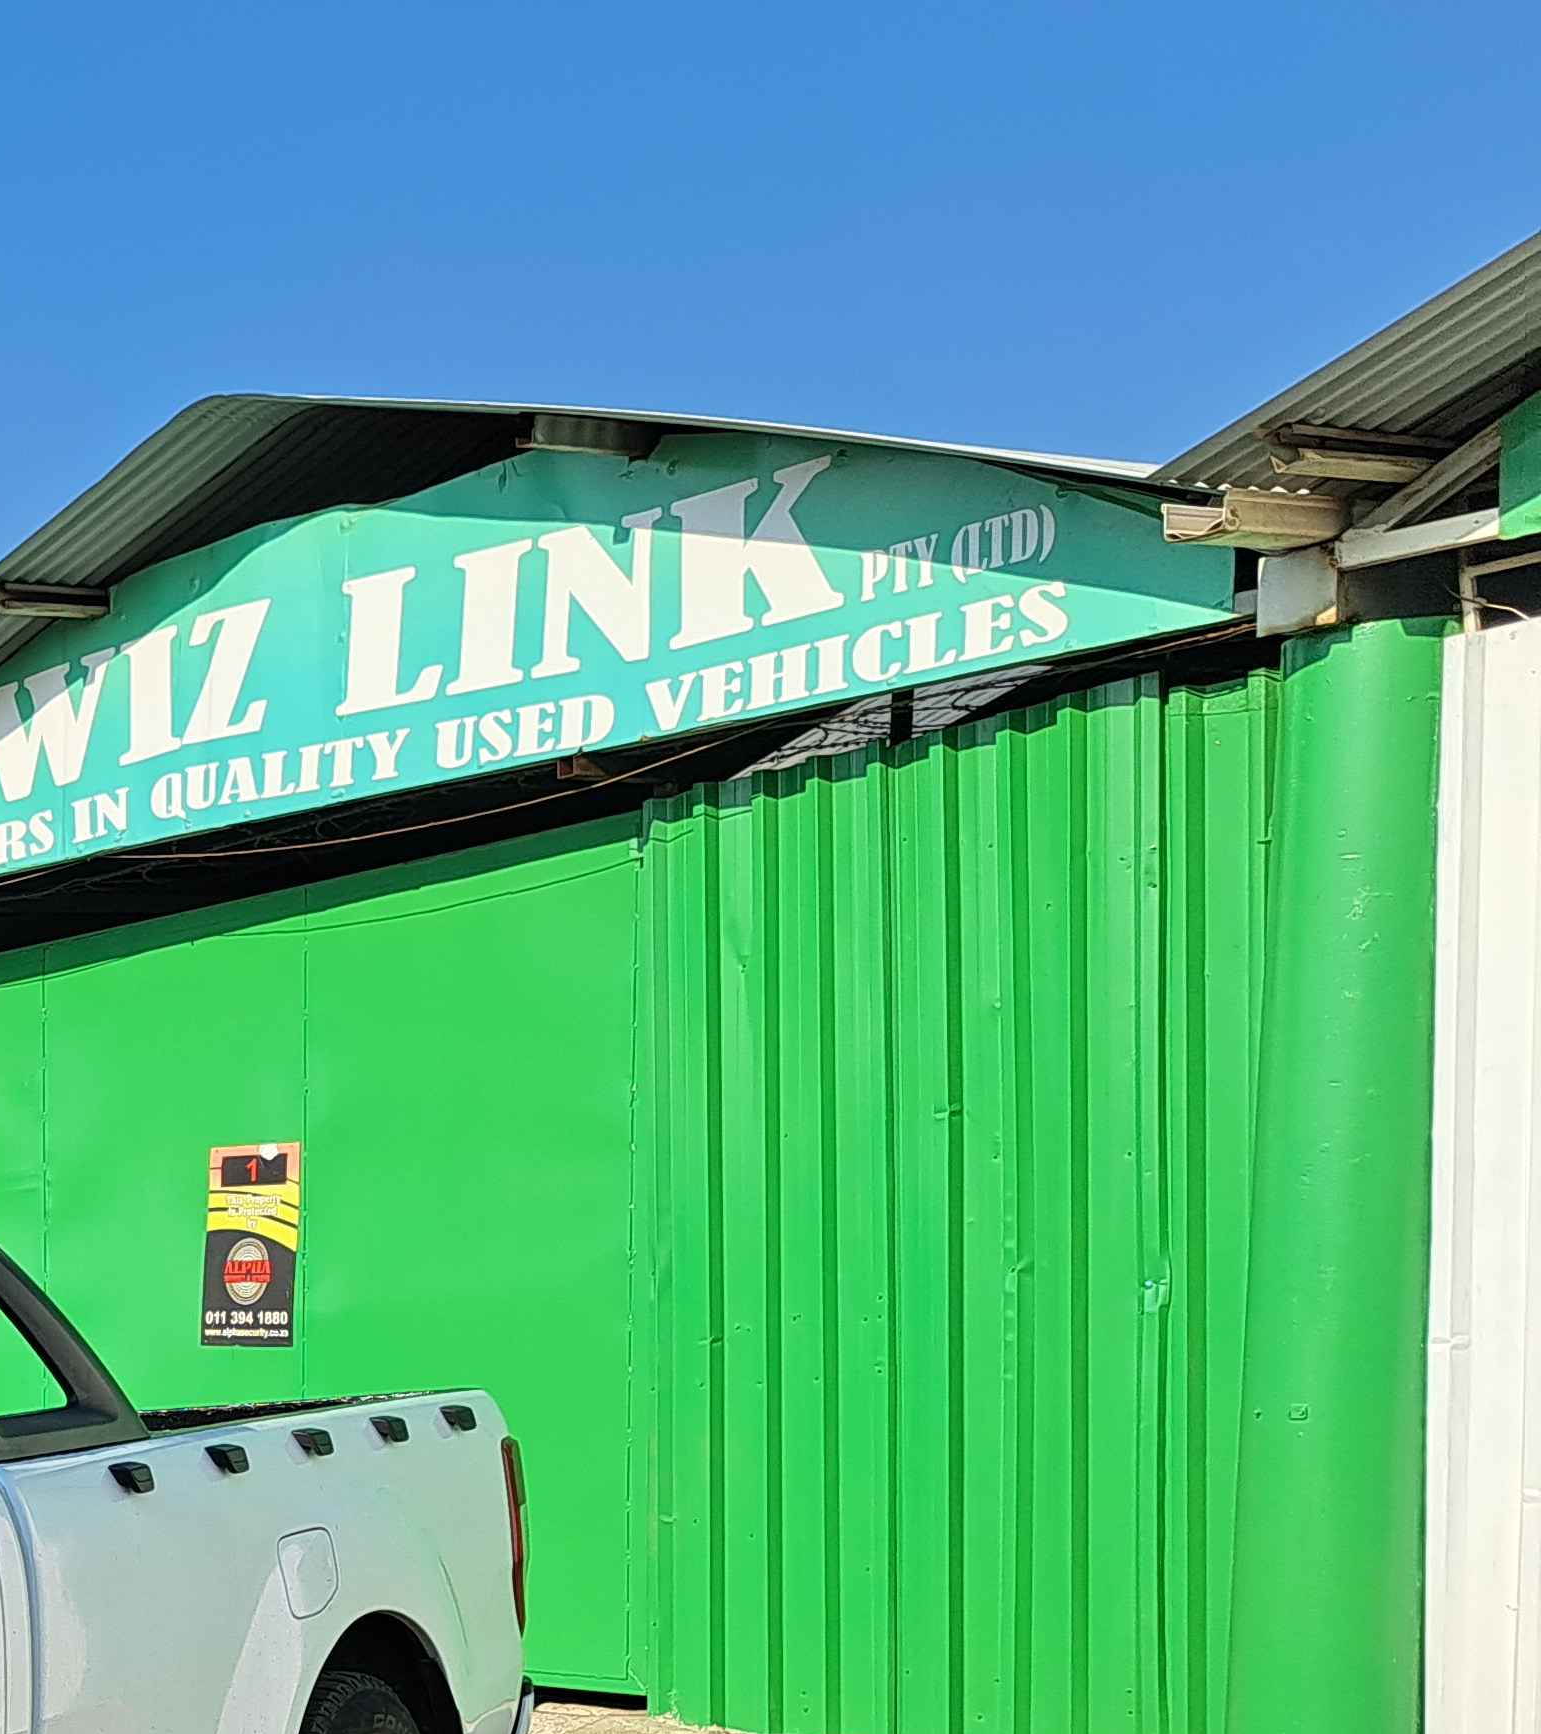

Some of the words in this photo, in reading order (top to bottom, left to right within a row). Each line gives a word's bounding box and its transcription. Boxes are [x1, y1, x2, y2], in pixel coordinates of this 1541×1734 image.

[336, 455, 844, 717] LINK
[861, 532, 939, 602] PTY
[951, 504, 1057, 584] (LTD)
[72, 788, 129, 843] IN
[151, 727, 411, 827] QUALITY
[436, 694, 614, 769] USED
[645, 581, 1068, 731] VEHICLES
[245, 1158, 258, 1182] 1
[225, 1261, 270, 1273] ALPHA
[205, 1310, 226, 1324] 011
[230, 1310, 253, 1325] 394
[257, 1310, 288, 1325] 1880
